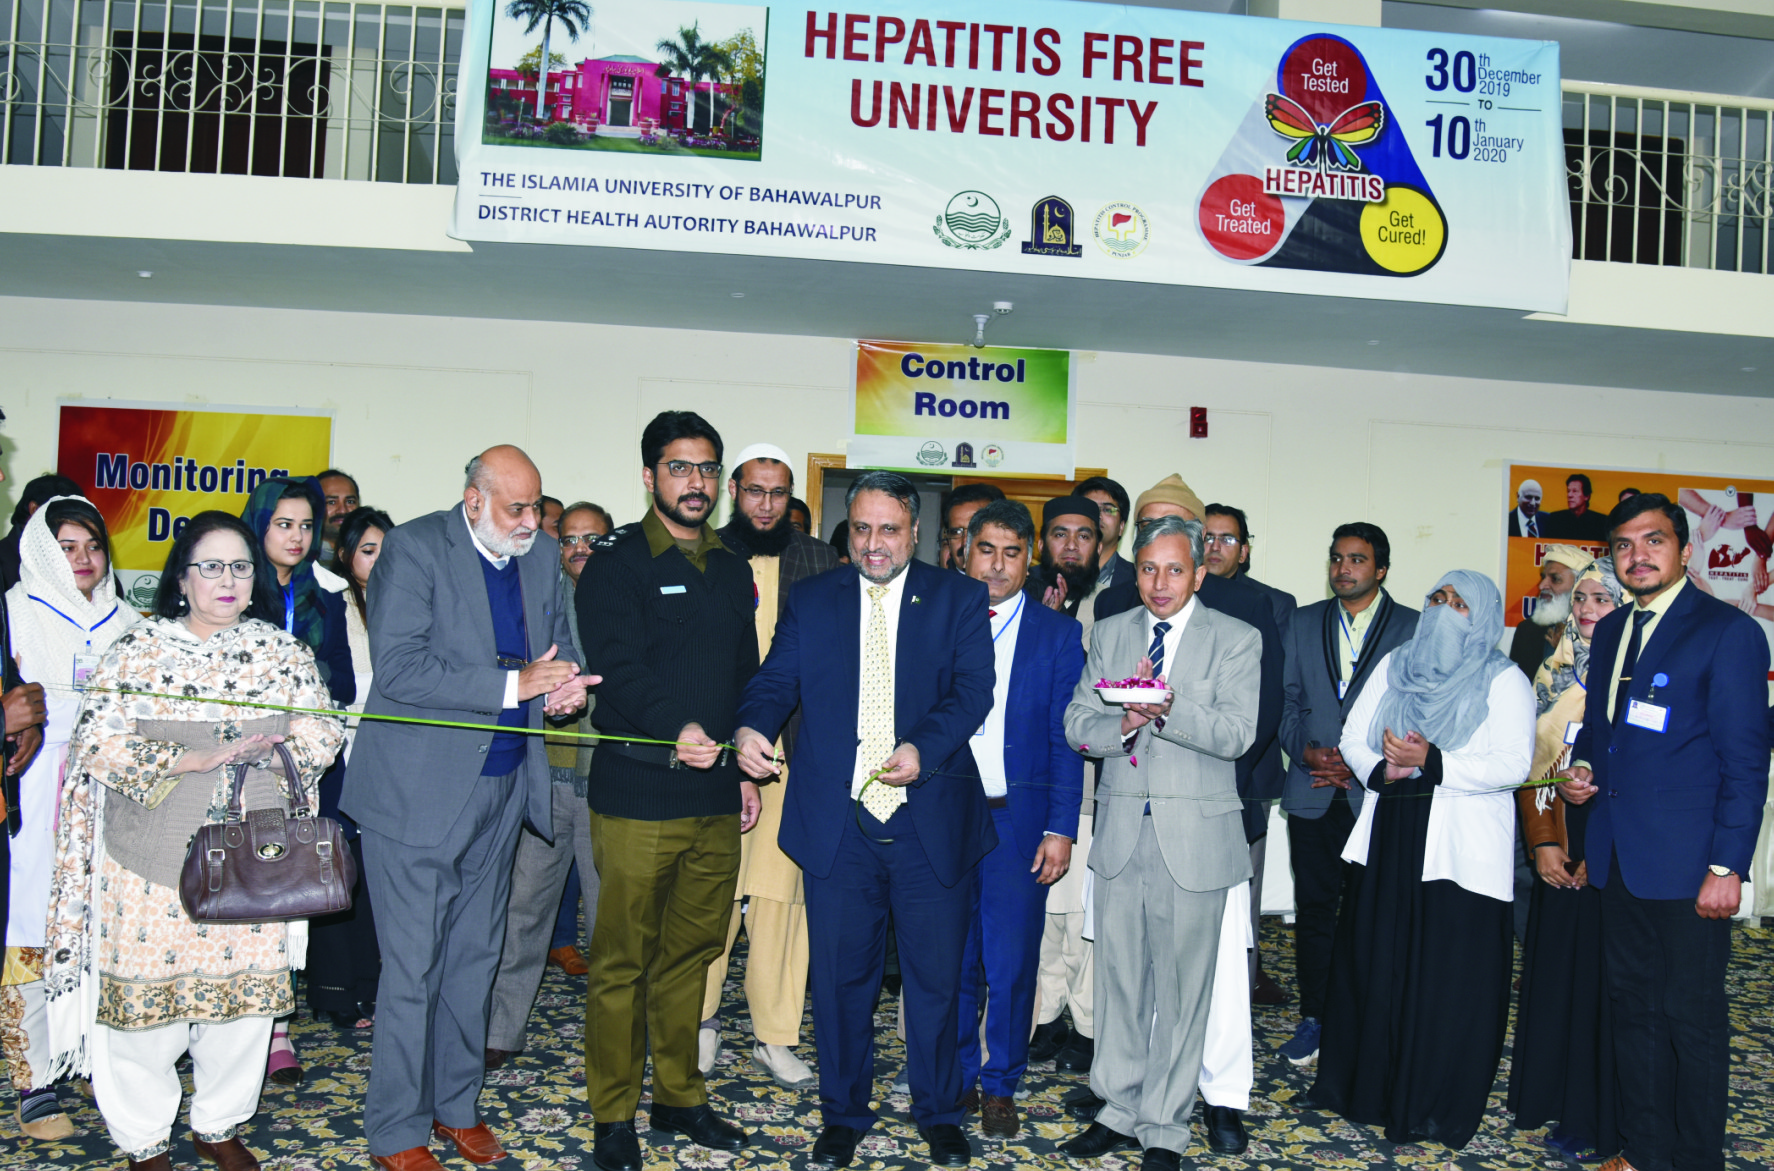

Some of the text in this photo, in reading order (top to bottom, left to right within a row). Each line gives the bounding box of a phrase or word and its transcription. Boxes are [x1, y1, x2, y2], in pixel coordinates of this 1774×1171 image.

[804, 10, 1205, 88] HEPATITIS FREE
[1312, 58, 1338, 77] Get
[1426, 47, 1491, 93] 30 th
[1478, 66, 1542, 86] December
[1301, 74, 1349, 94] Tested
[1479, 80, 1511, 98] 2019
[850, 78, 1159, 147] UNIVERSITY
[1478, 99, 1493, 111] TO
[1425, 113, 1486, 160] 10 th
[1472, 134, 1524, 153] January
[1473, 147, 1507, 163] 2020
[480, 171, 882, 211] THE ISLAMIA UNIVERSITY OF BAHAWALPUR
[1265, 168, 1382, 200] HEPATITIS
[1230, 199, 1256, 217] Get
[477, 204, 877, 243] DISTRICT HEALTH AUTORITY BAHAWALPUR
[1215, 214, 1271, 235] Treated
[1389, 210, 1414, 230] Get
[1377, 225, 1427, 246] Cured!
[900, 352, 1026, 383] Control
[914, 391, 1010, 420] Room
[95, 453, 290, 494] Monitorin
